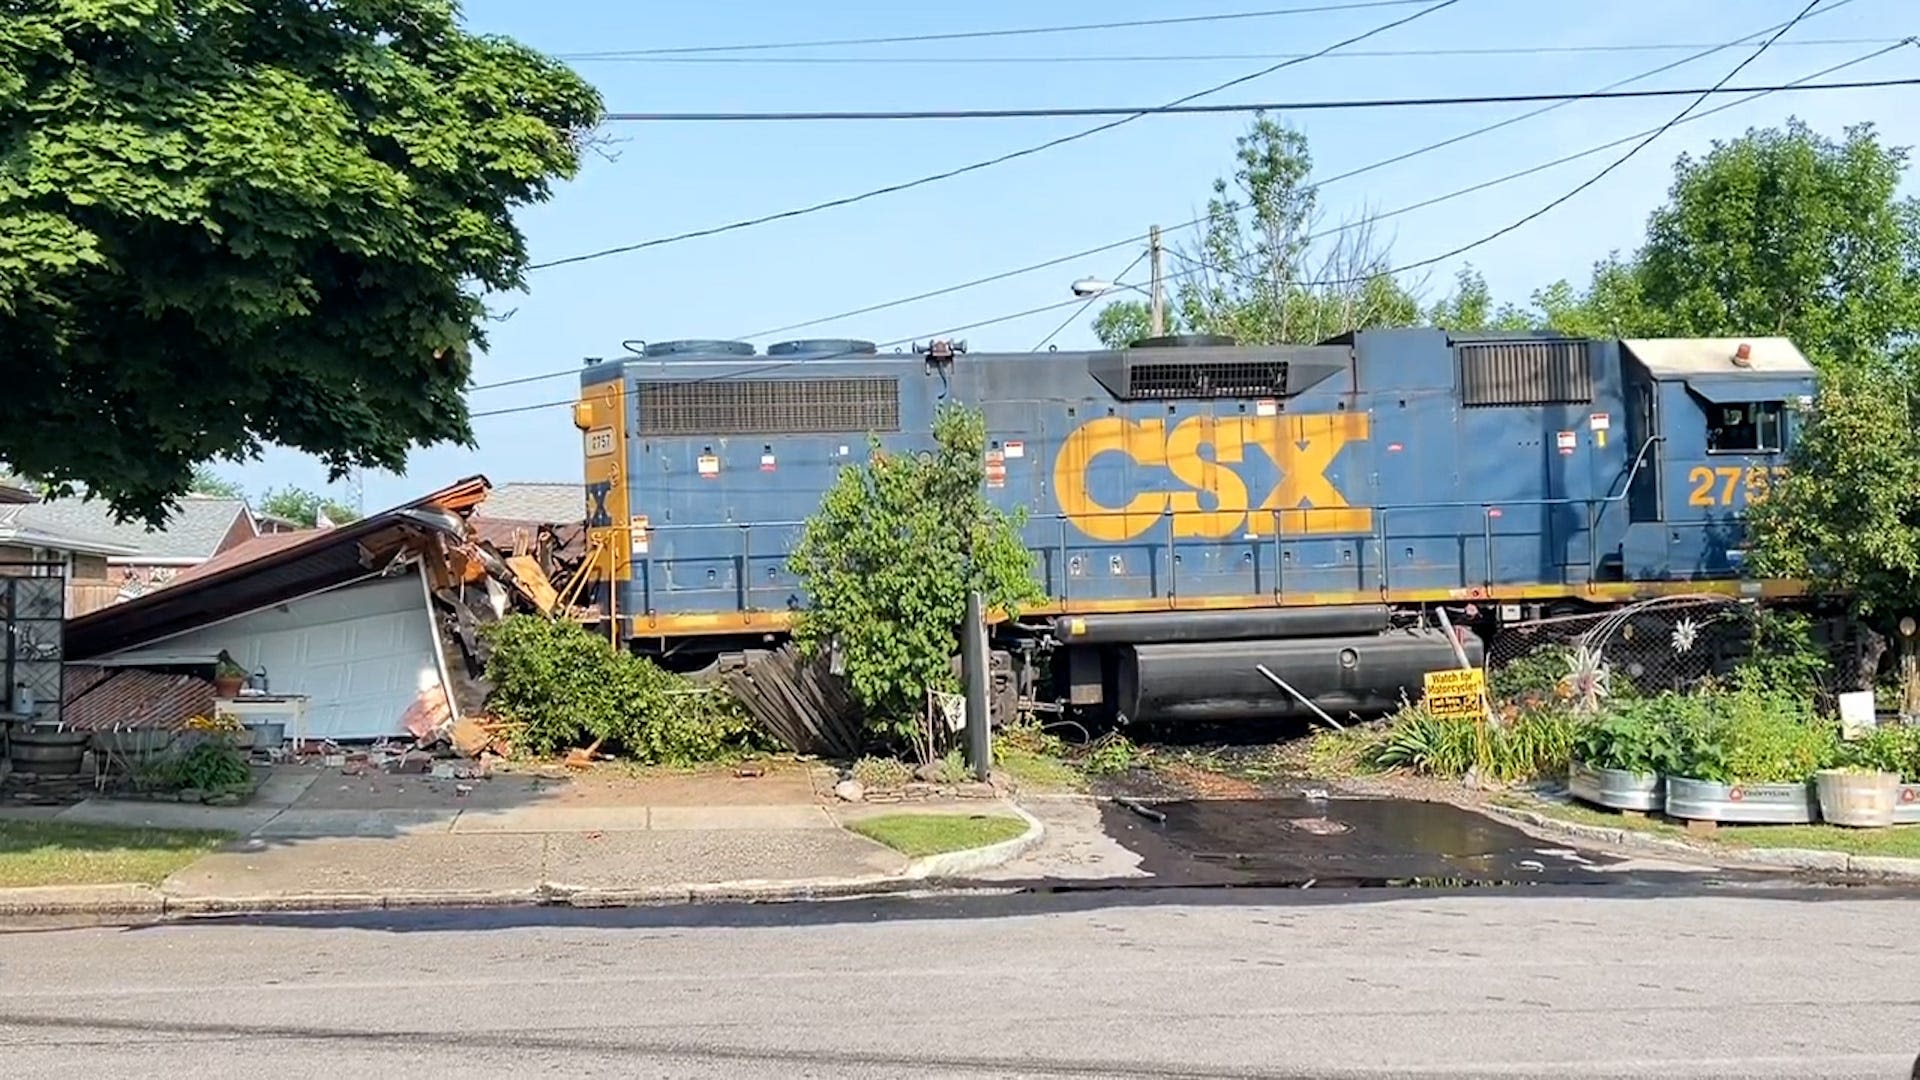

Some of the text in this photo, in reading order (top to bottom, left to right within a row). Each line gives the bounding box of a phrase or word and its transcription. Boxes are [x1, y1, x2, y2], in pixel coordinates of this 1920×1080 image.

[592, 433, 611, 450] 2757
[1053, 412, 1372, 541] CSX
[1432, 671, 1472, 683] Watch for
[1428, 682, 1478, 694] Motorcycles
